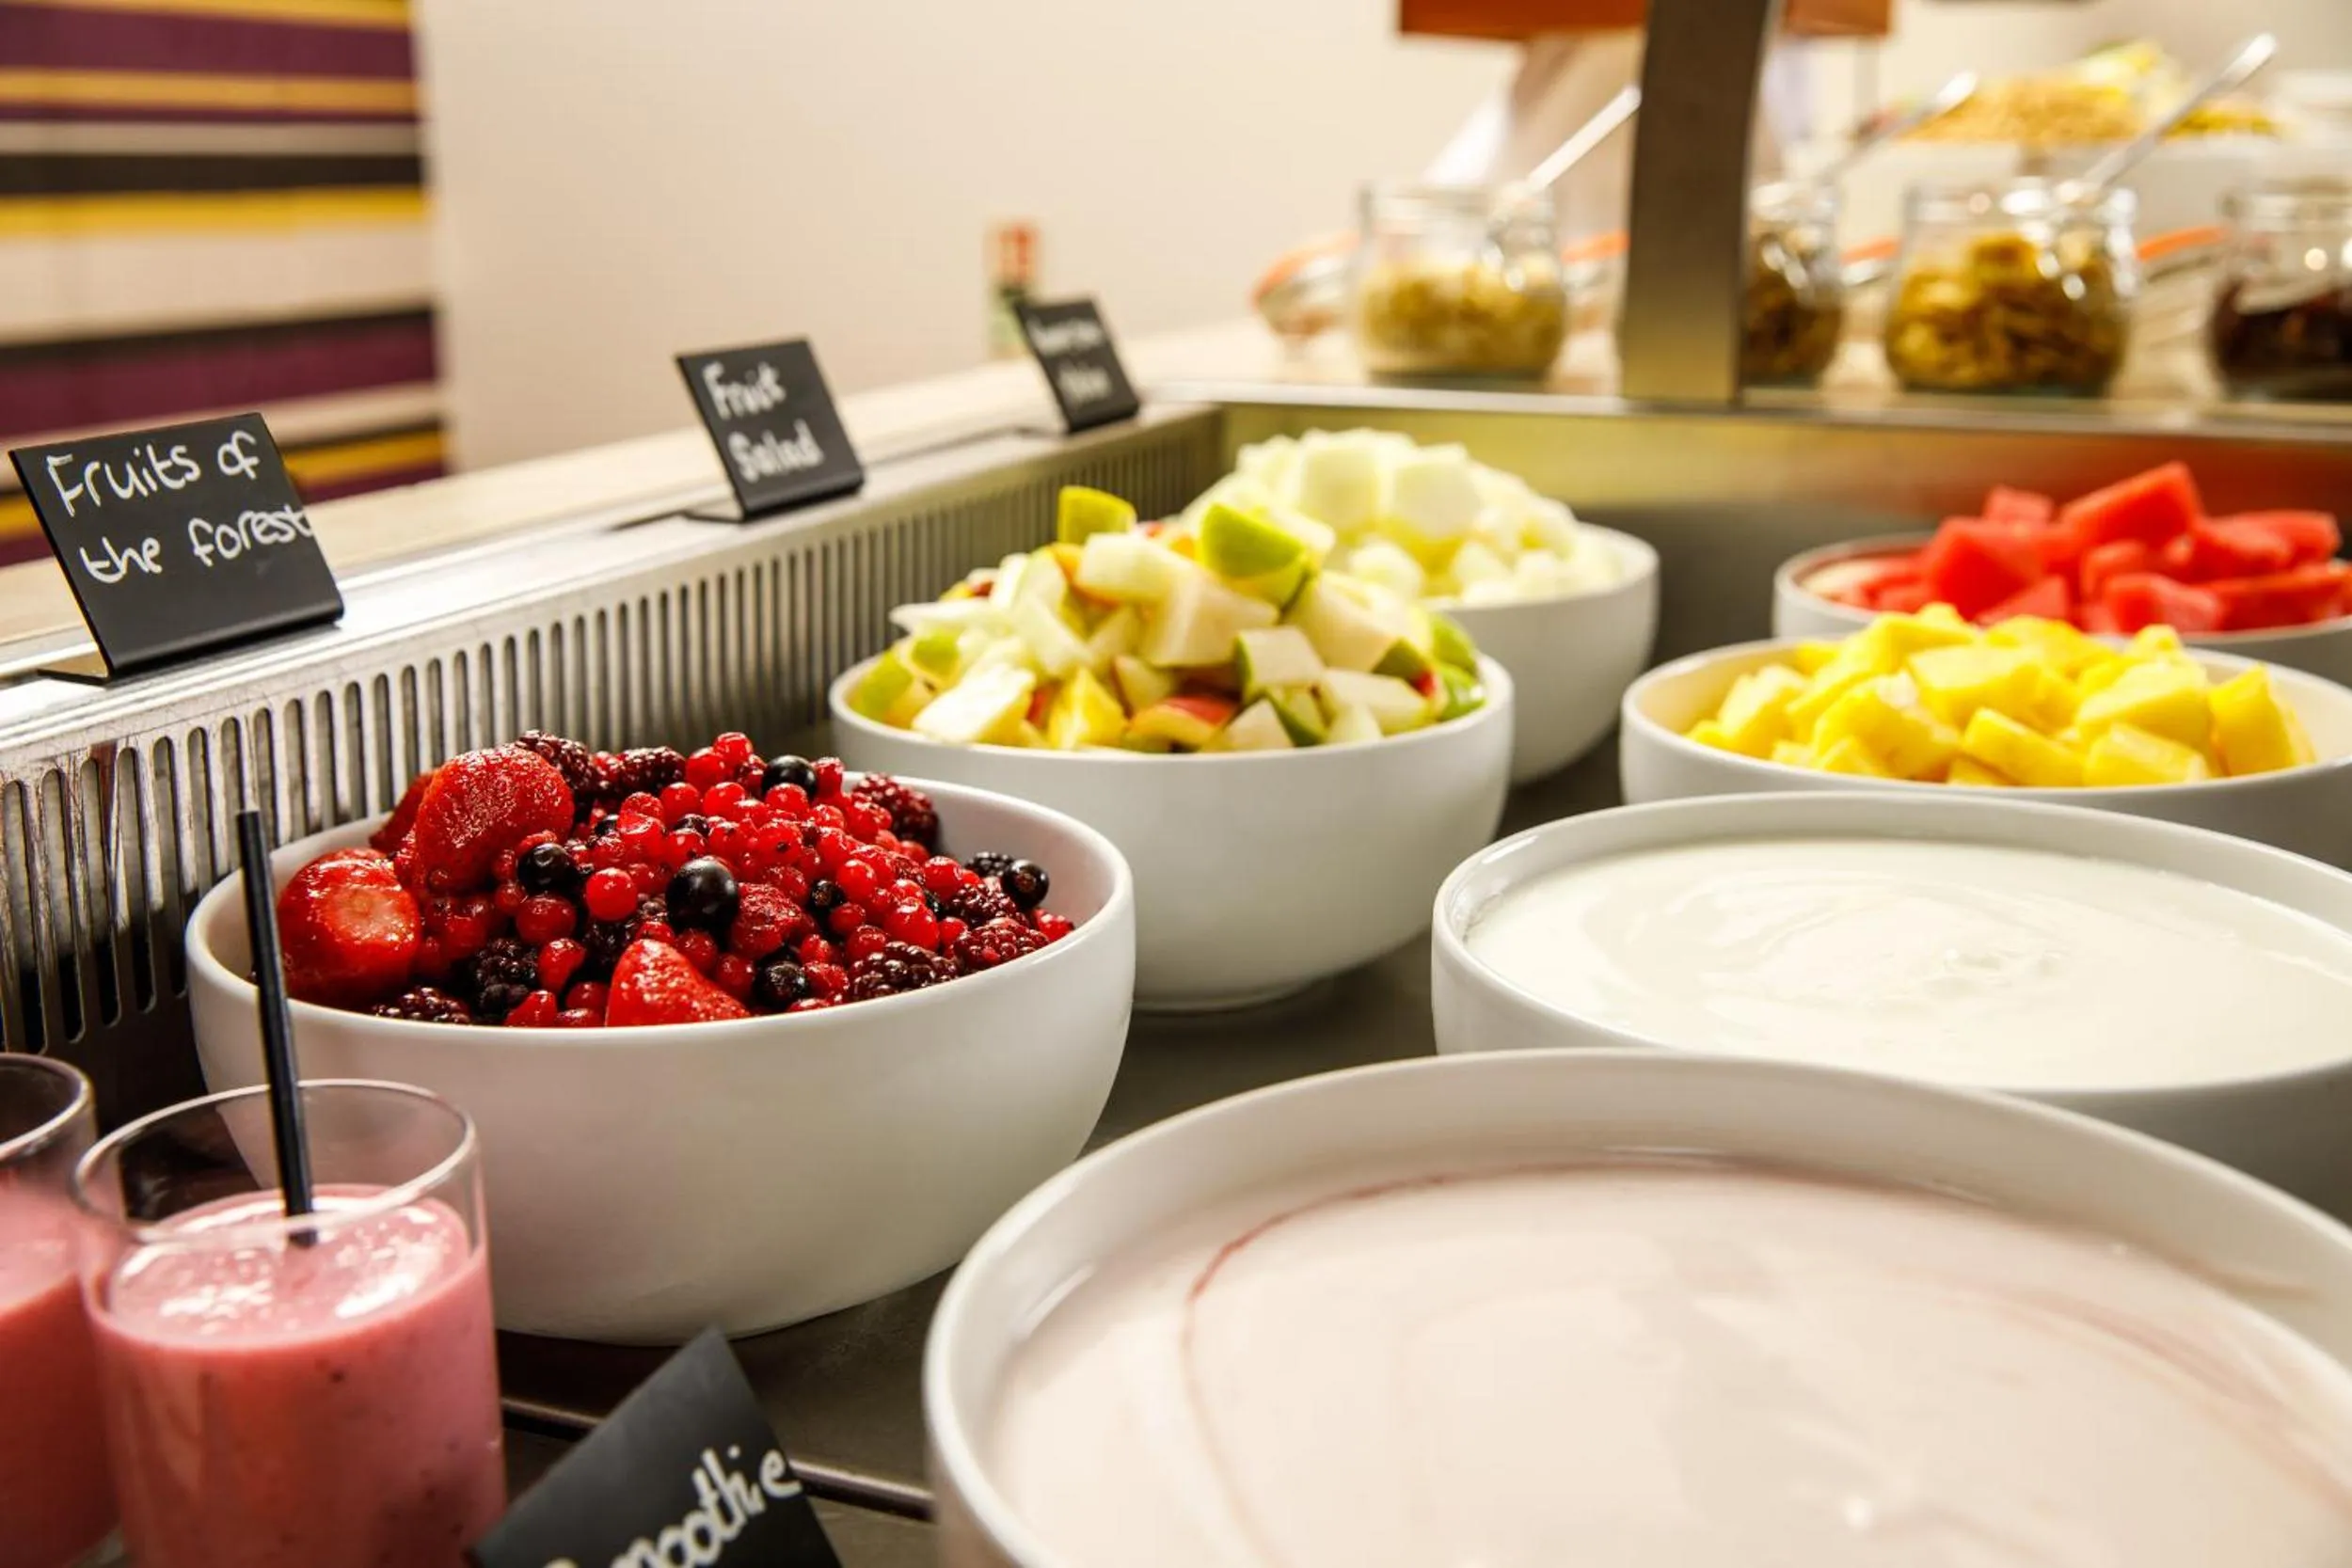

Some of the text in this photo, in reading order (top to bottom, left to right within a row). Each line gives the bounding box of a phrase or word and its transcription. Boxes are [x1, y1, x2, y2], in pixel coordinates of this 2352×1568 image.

[703, 361, 786, 420] Fruit
[47, 430, 261, 516] Fruits of
[727, 419, 824, 483] Salad
[79, 504, 314, 583] the forest
[543, 1446, 803, 1568] oothie
